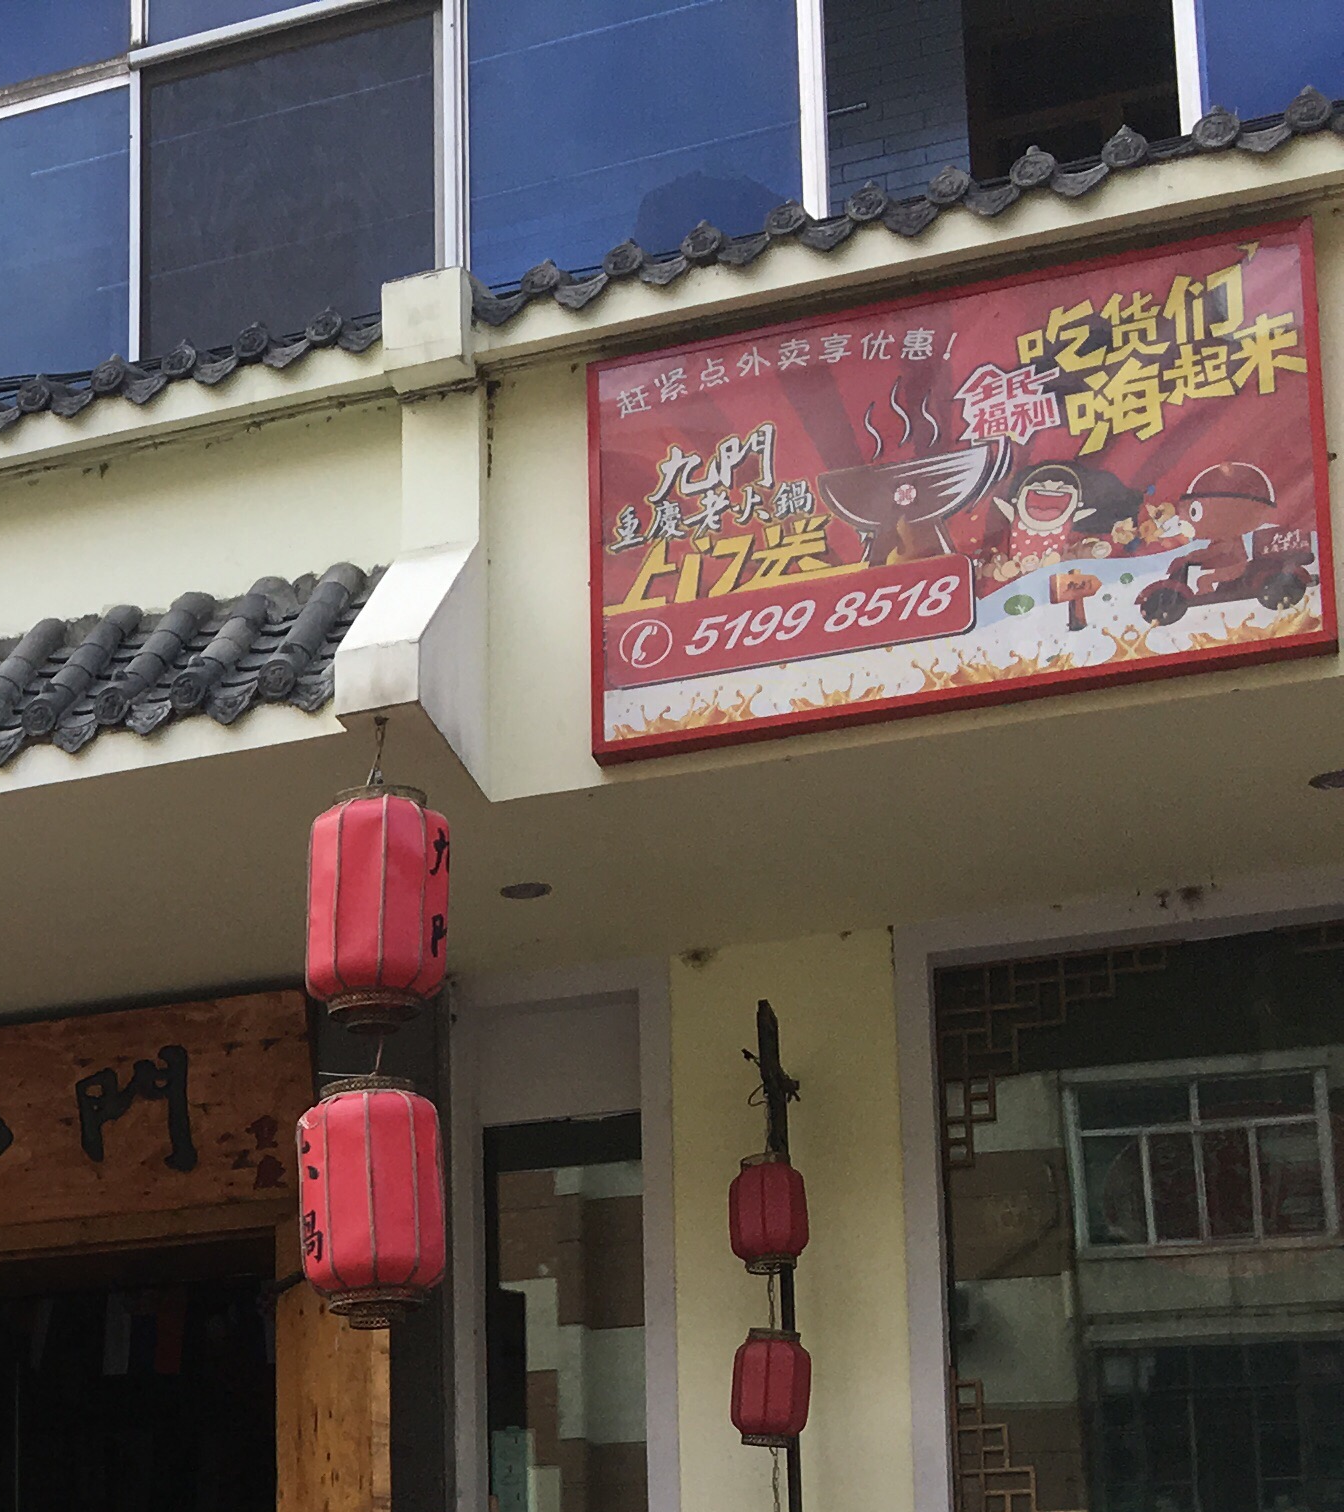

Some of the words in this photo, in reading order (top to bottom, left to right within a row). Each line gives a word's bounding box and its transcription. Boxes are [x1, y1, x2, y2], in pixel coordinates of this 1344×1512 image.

[1016, 263, 1245, 371] 吃货们
[1064, 311, 1308, 456] 嗨起来
[648, 423, 775, 502] 九門
[610, 481, 813, 551] 重慶老火鍋
[684, 599, 816, 656] 5199
[823, 574, 960, 634] 8518
